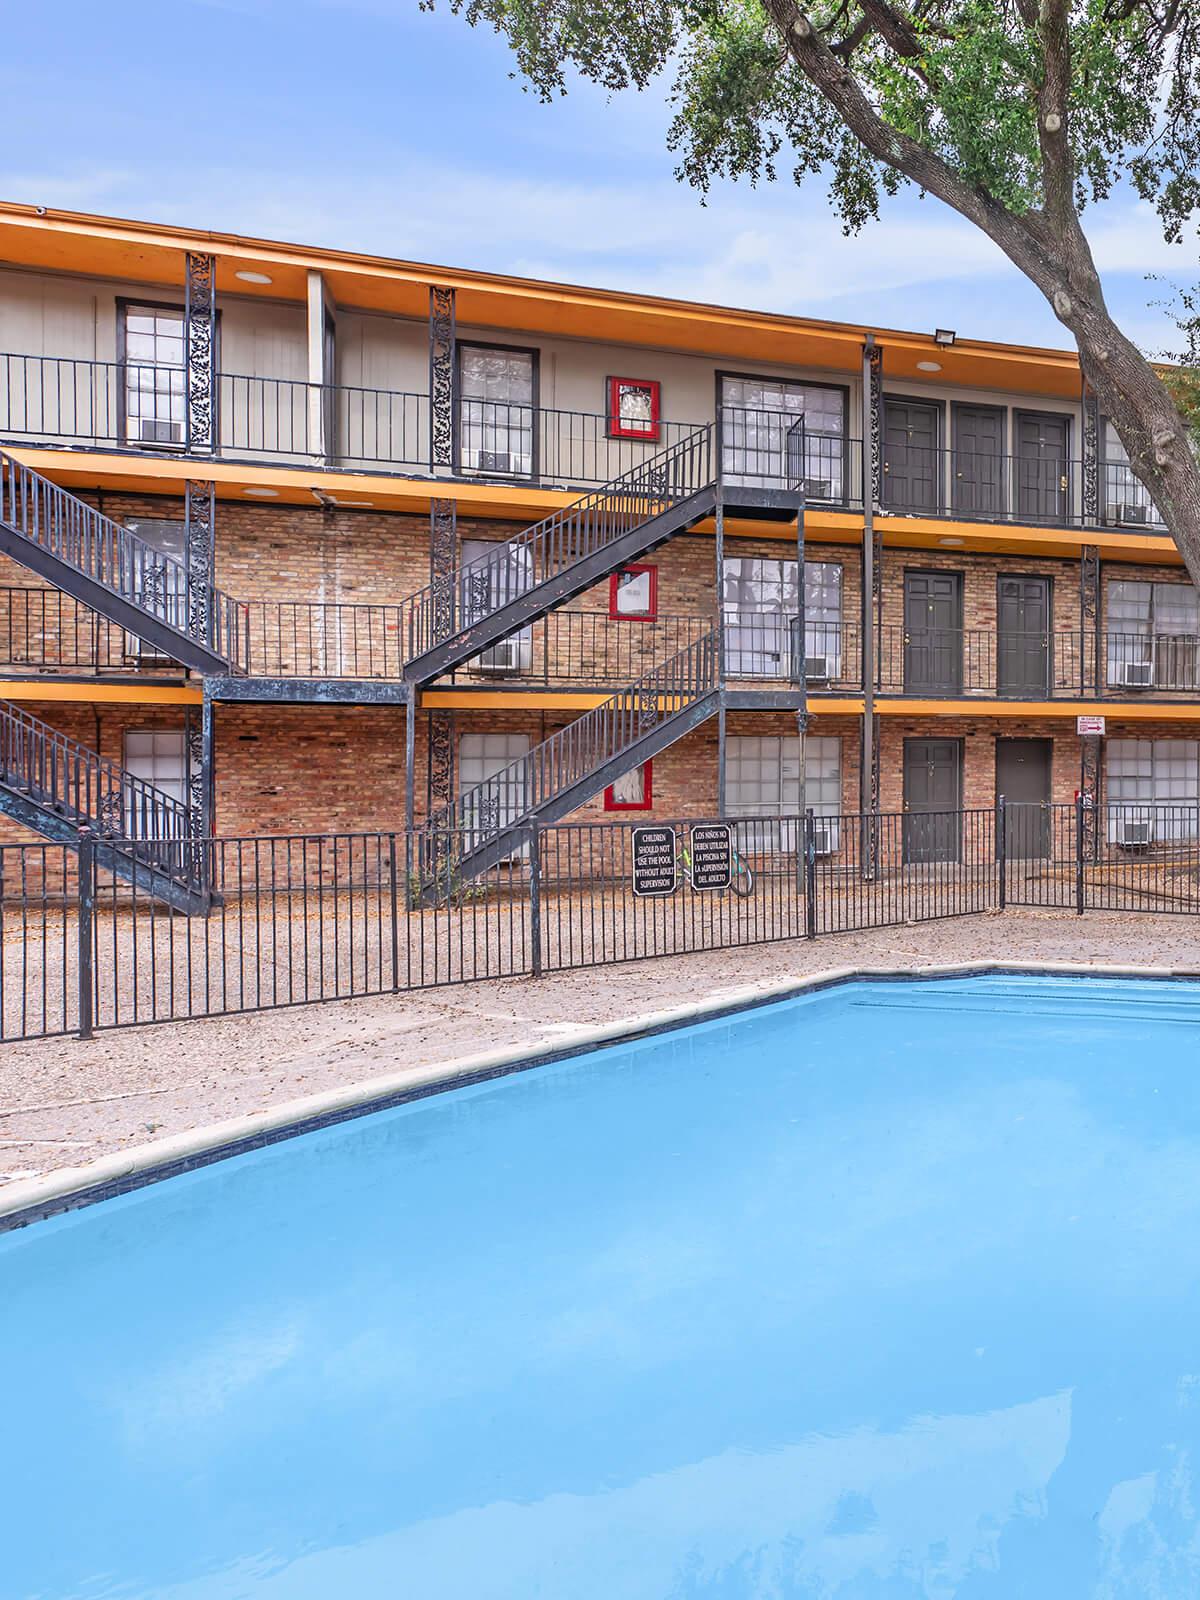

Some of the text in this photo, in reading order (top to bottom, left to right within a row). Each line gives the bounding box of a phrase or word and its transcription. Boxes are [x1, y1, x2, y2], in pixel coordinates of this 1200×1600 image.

[642, 833, 666, 842] CHILDREN
[695, 831, 704, 840] LOS
[638, 845, 670, 854] SHOULD NOT
[694, 841, 728, 851] DEBEN UTILIZAR
[638, 856, 672, 866] USE THE POOL
[695, 854, 702, 862] LA
[702, 853, 719, 861] PISCINA
[635, 866, 674, 877] WITHOUT ADULT
[694, 864, 701, 873] LA
[698, 874, 726, 883] DEL ADULTO
[640, 879, 670, 888] SUPERVISION
